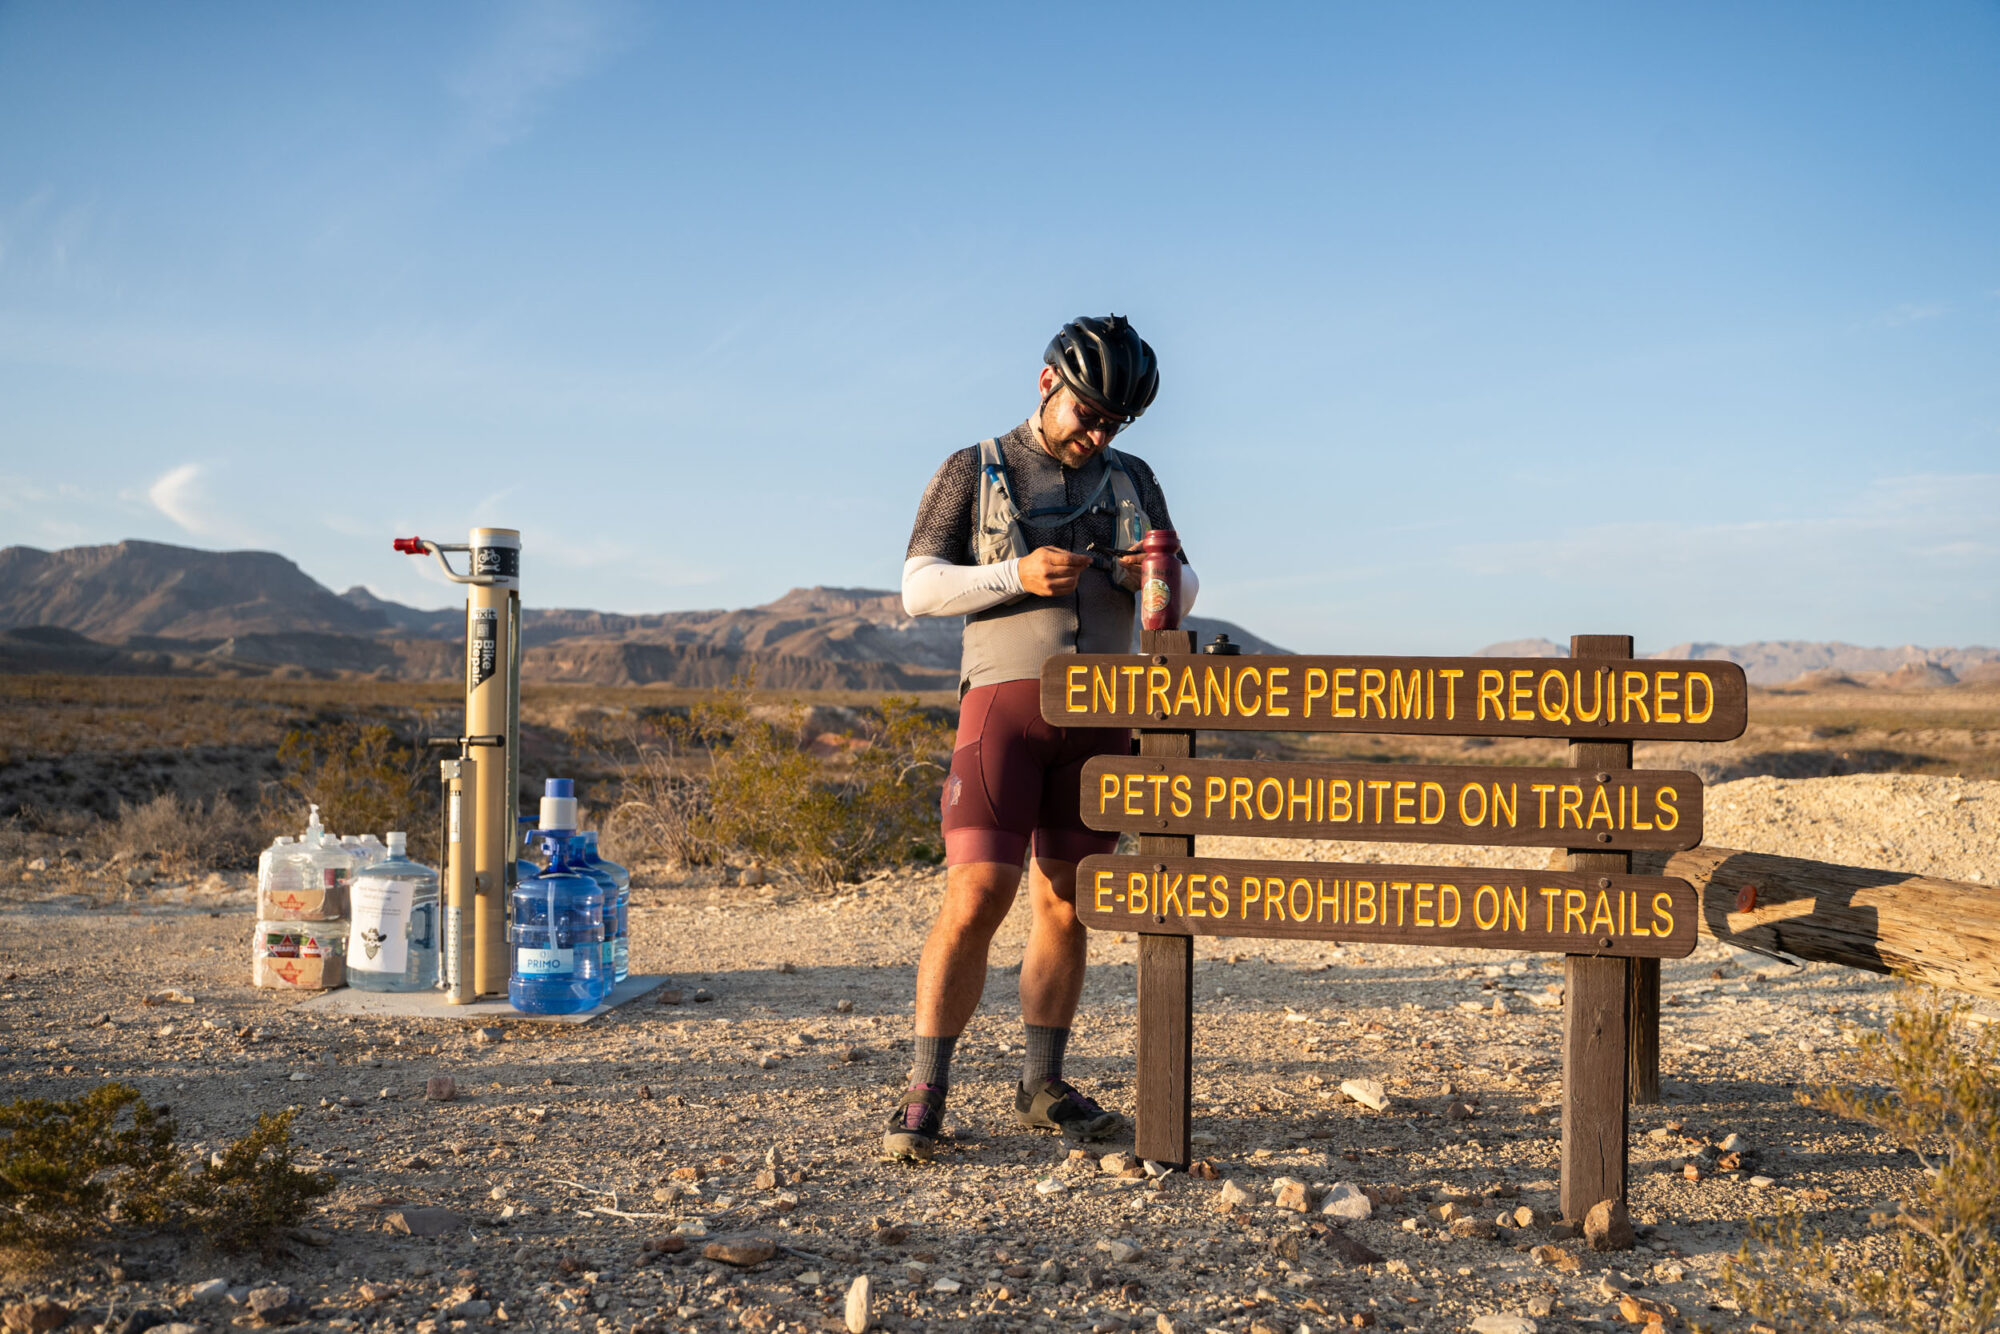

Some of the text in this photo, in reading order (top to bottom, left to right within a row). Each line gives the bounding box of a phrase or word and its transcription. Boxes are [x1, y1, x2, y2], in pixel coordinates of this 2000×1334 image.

[471, 639, 483, 685] Repair
[482, 639, 495, 670] Bike
[1065, 664, 1715, 726] ENTRANCE PERMIT REQUIRED
[1099, 773, 1680, 832] PETS PROHIBITED ON TRAILS
[1094, 870, 1675, 939] E-BIKES PROHIBITED ON TRAILS
[527, 959, 561, 969] PRIMO
